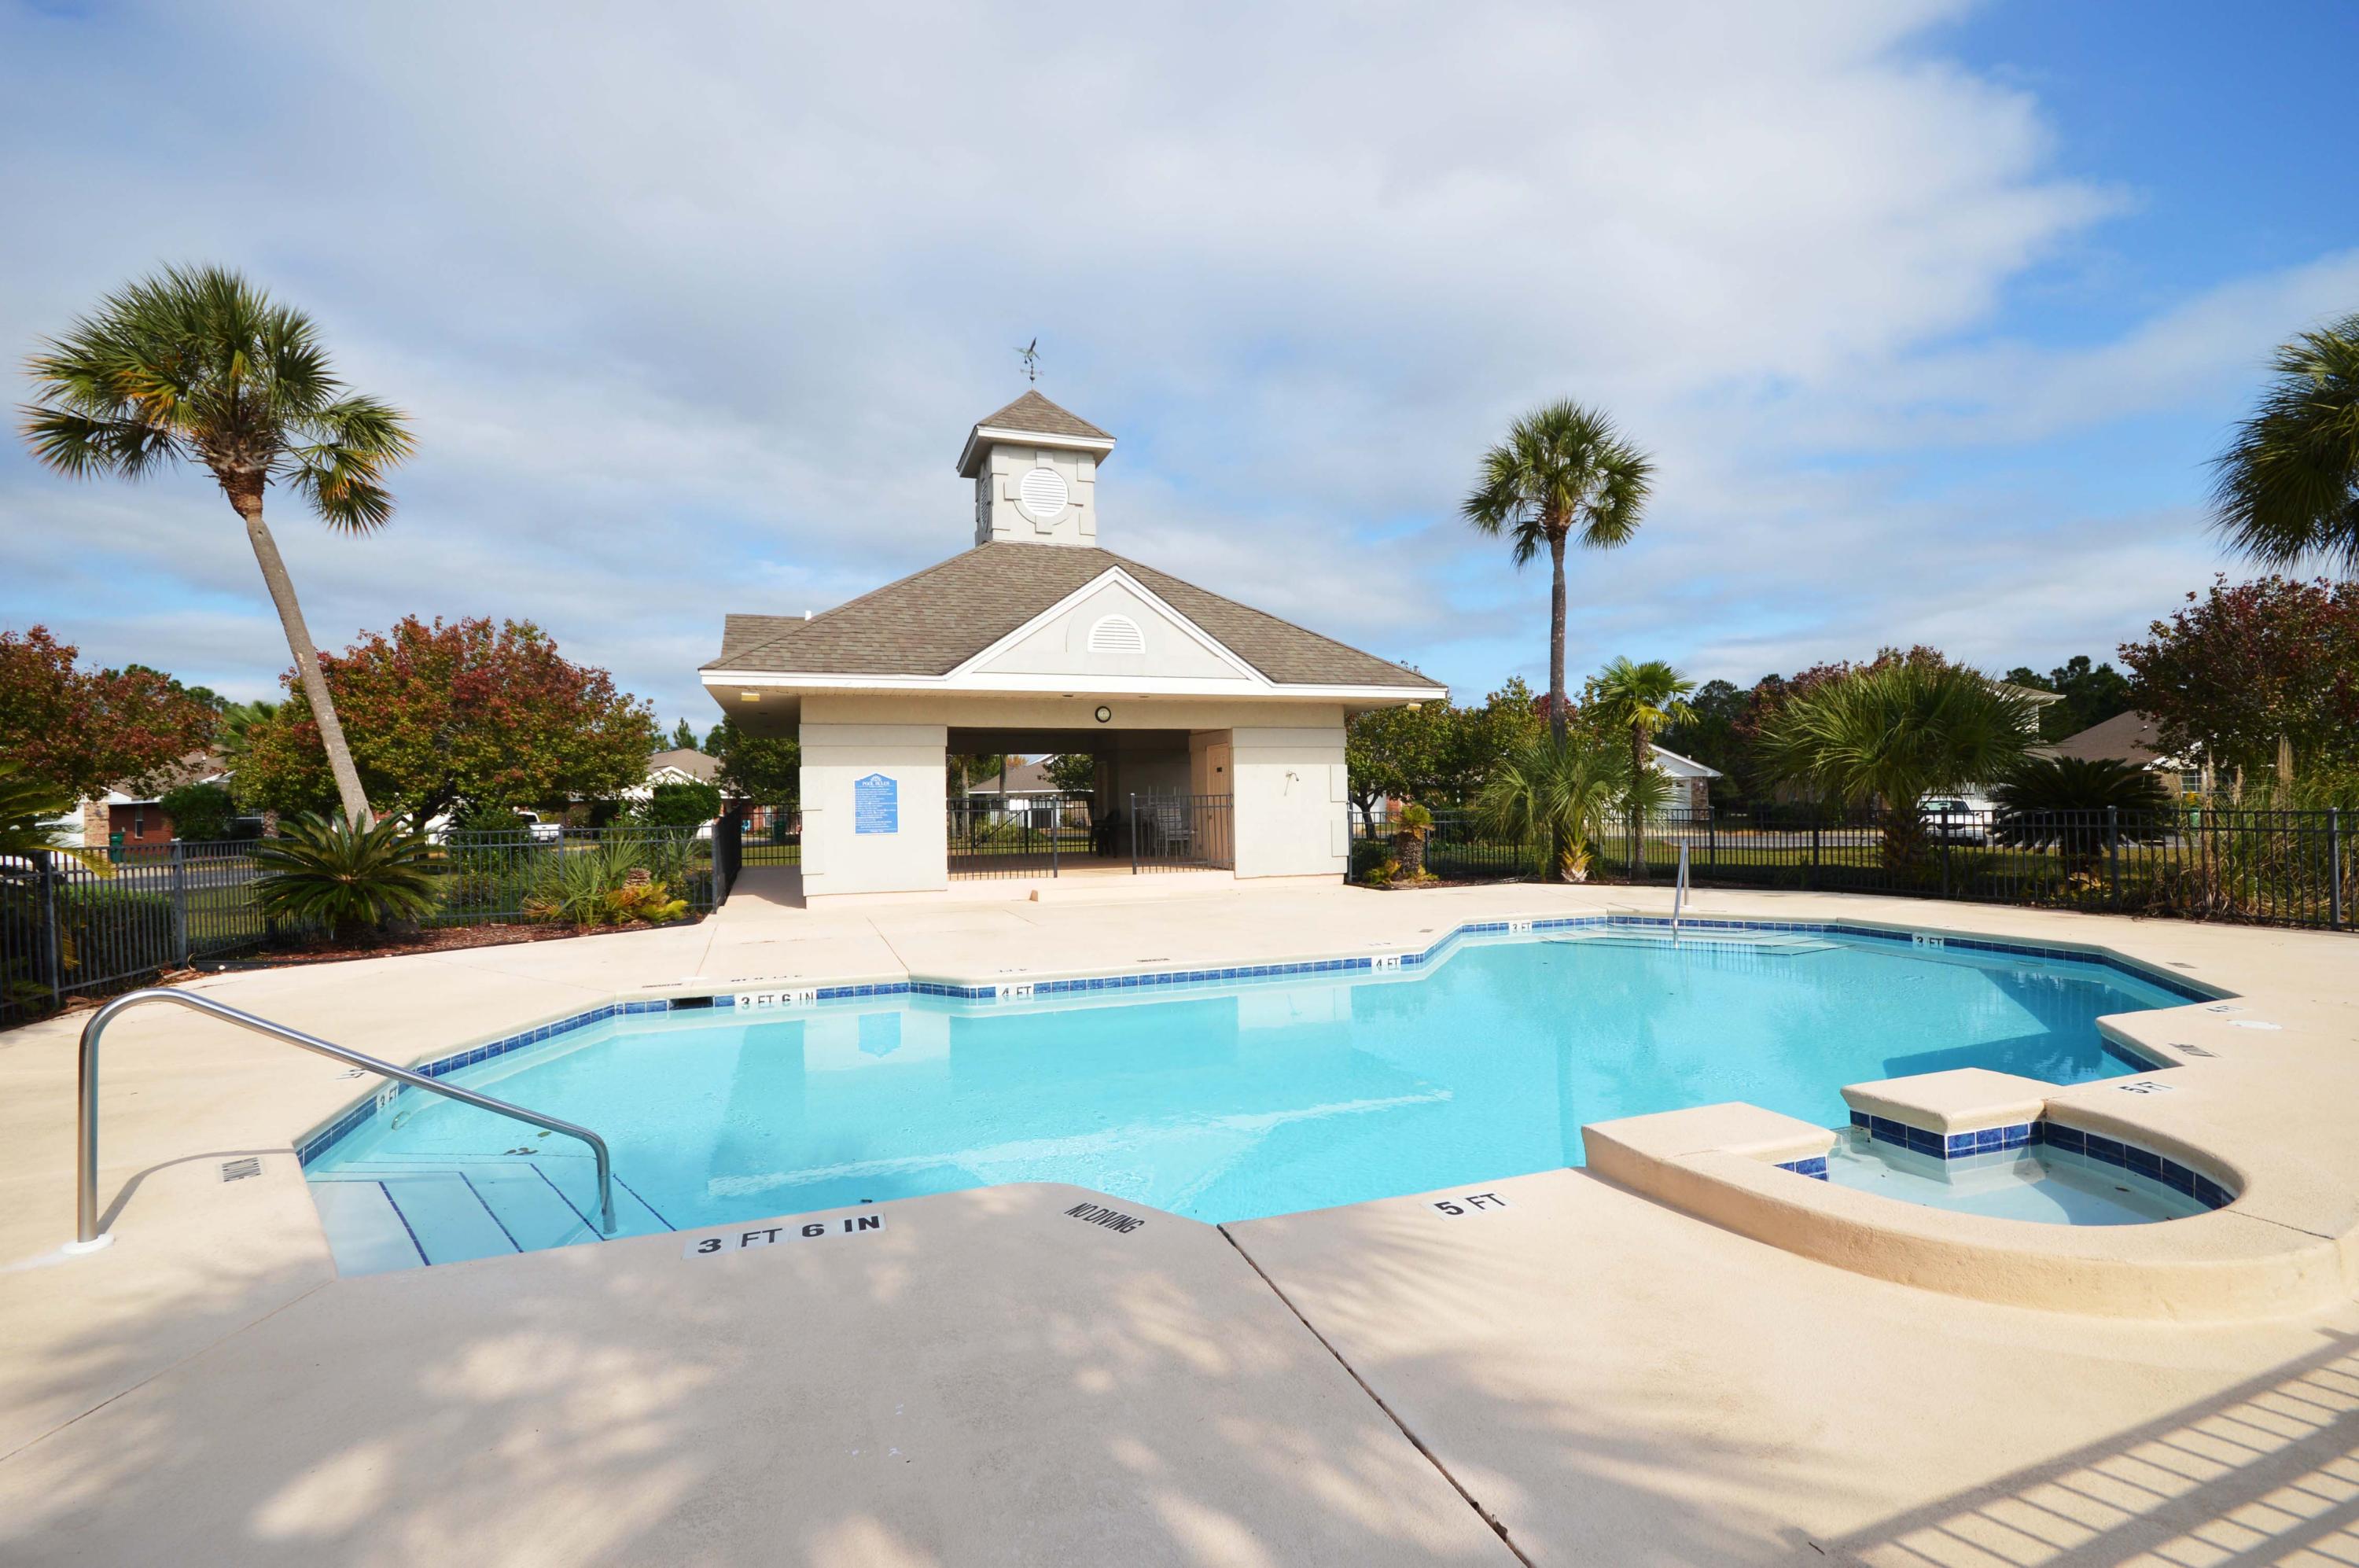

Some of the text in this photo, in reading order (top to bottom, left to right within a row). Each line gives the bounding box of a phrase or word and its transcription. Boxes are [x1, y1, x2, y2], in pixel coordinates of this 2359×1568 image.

[2136, 1081, 2173, 1091] FT
[1063, 1202, 1145, 1234] NO DIVING
[1433, 1193, 1506, 1216] 5 FT
[697, 1216, 880, 1253] 3 FT 6 IN
